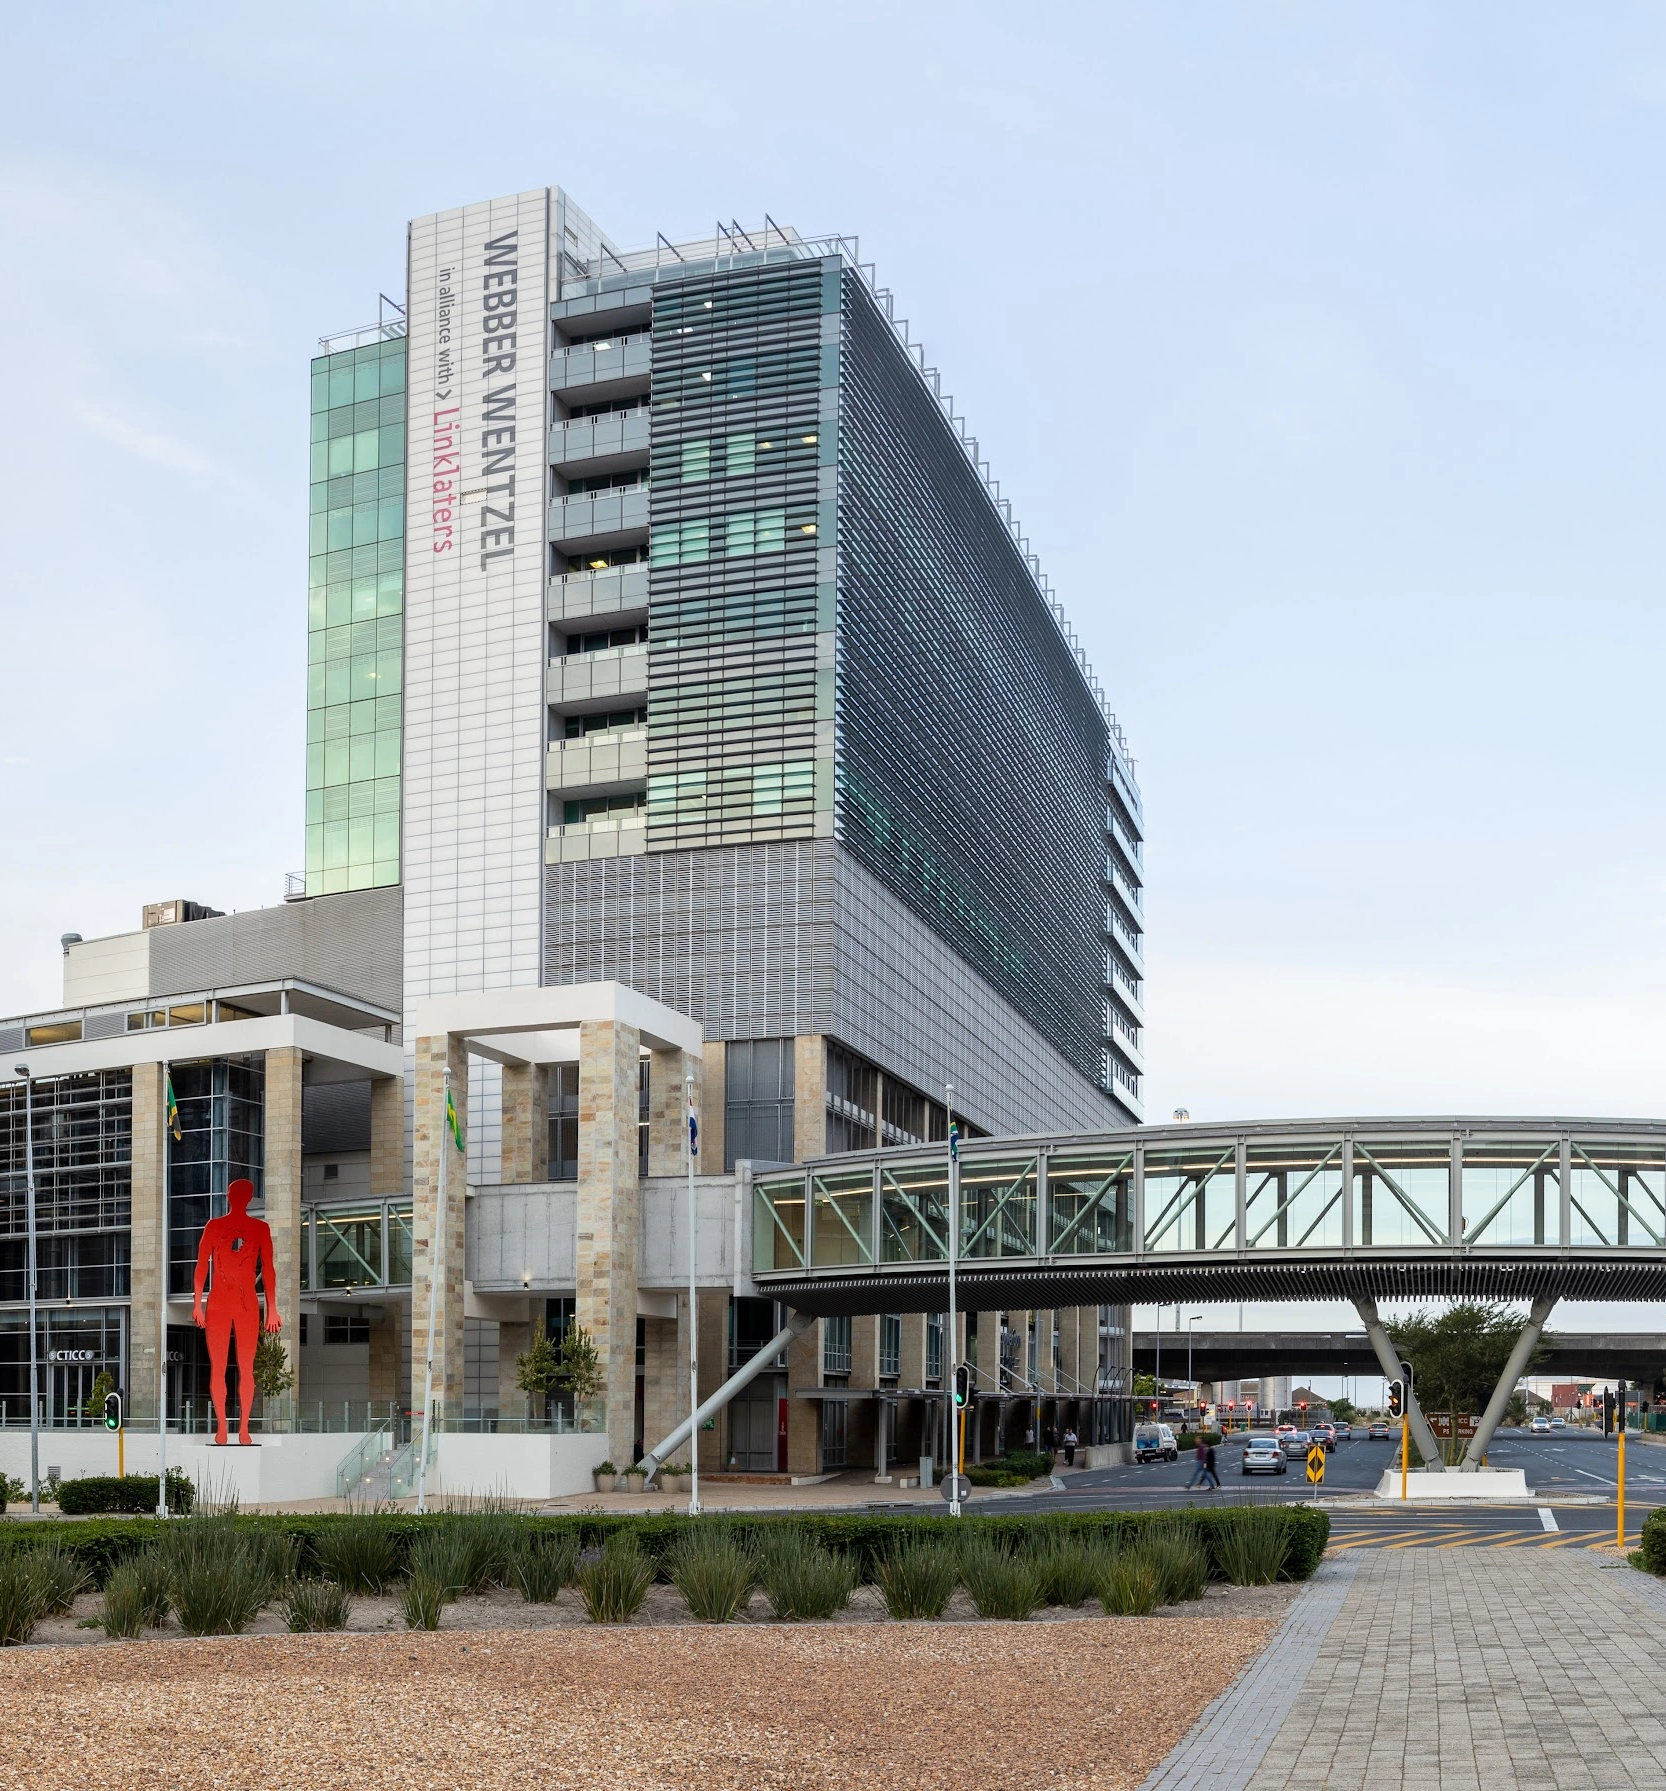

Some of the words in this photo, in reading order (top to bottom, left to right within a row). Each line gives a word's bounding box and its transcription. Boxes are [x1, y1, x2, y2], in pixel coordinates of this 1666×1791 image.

[439, 267, 455, 283] in
[482, 229, 518, 379] WEBBER
[438, 286, 455, 344] alliance
[437, 348, 454, 385] with
[432, 407, 461, 553] Linklaters
[480, 382, 517, 572] WENTZEL
[56, 1350, 85, 1361] CTICC
